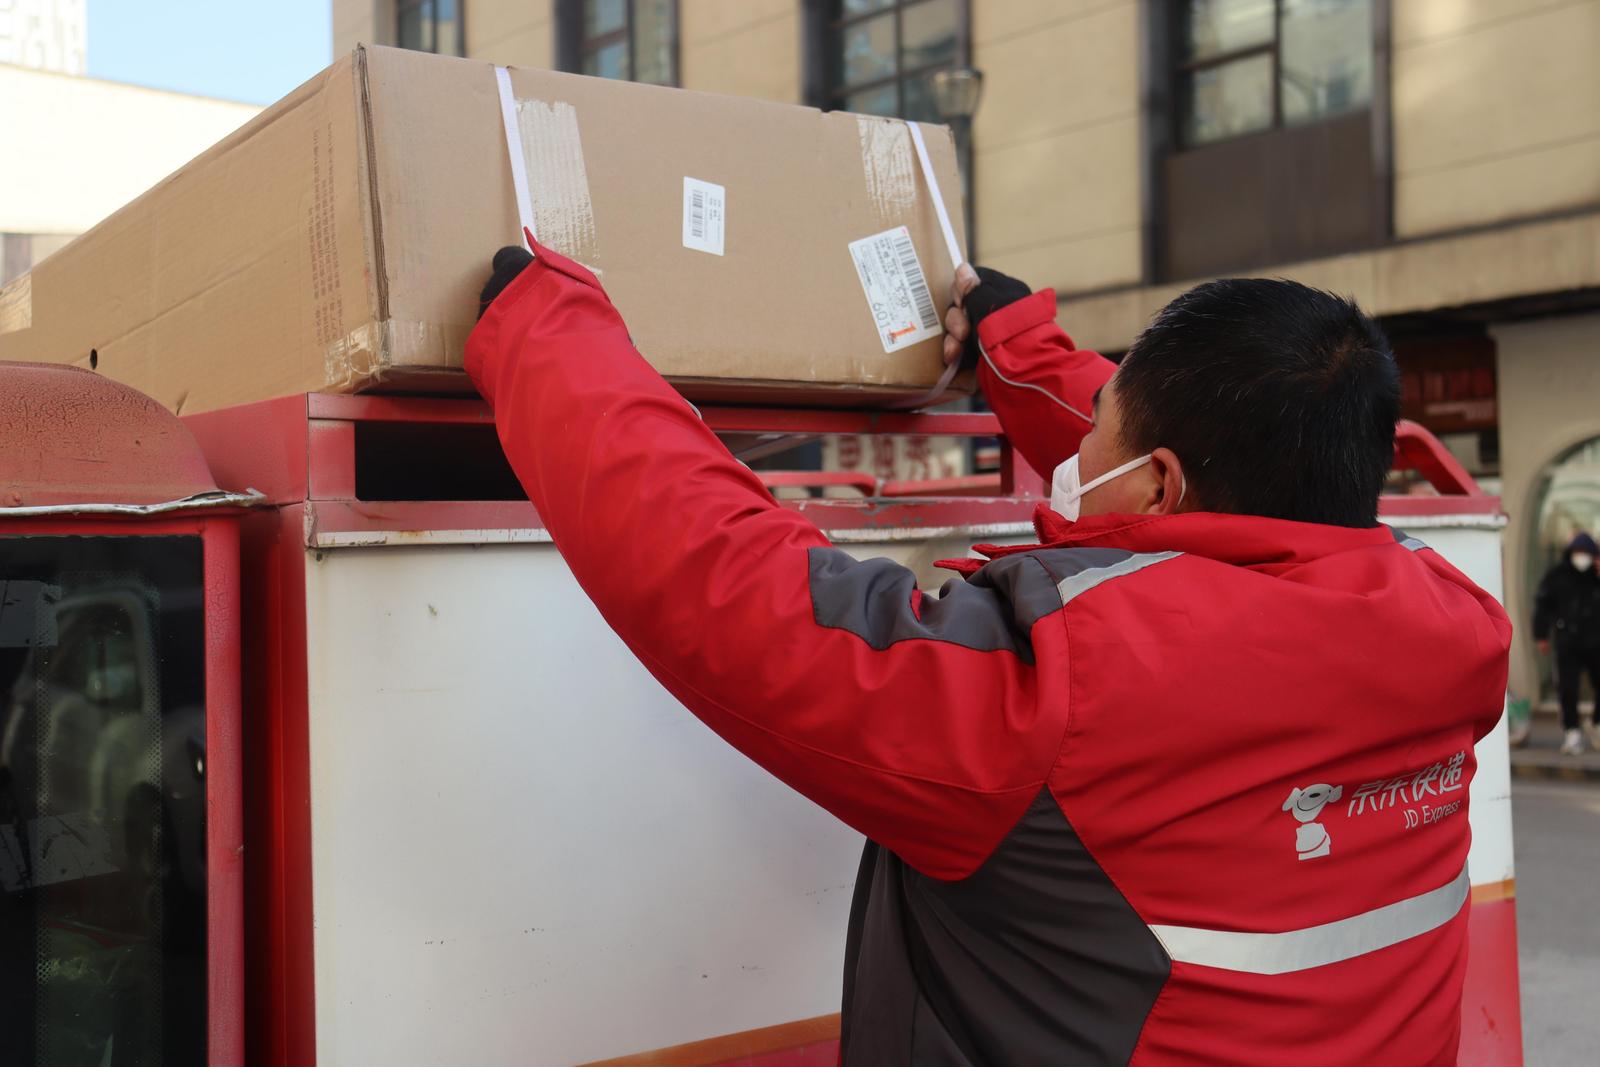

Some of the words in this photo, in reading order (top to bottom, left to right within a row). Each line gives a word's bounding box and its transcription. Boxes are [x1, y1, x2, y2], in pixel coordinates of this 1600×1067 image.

[1347, 750, 1465, 817] 京东快递
[1403, 809, 1419, 829] JD
[1422, 800, 1461, 824] Express
